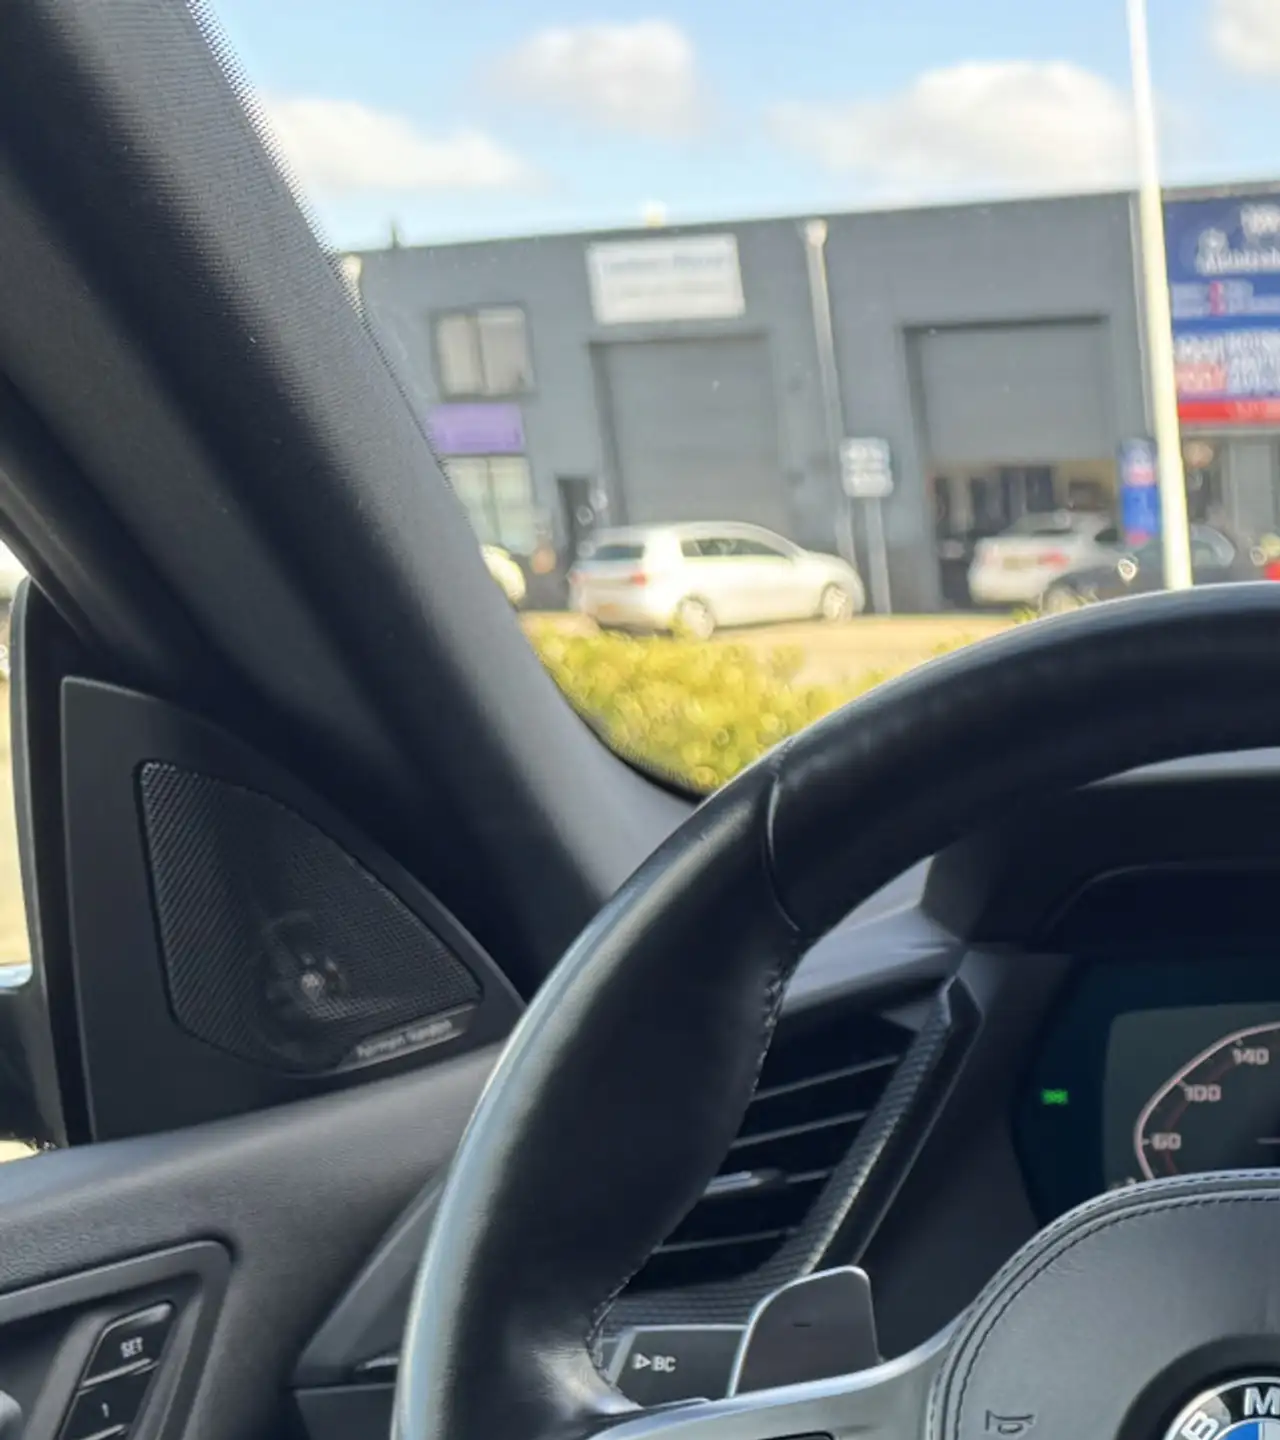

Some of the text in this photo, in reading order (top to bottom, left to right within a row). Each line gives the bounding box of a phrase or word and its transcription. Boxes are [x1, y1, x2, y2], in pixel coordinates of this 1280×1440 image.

[1232, 1048, 1270, 1065] 140
[1183, 1084, 1222, 1102] 100
[1151, 1132, 1182, 1150] 60
[121, 1336, 144, 1359] SET
[652, 1355, 677, 1372] BC
[102, 1402, 110, 1418] 1
